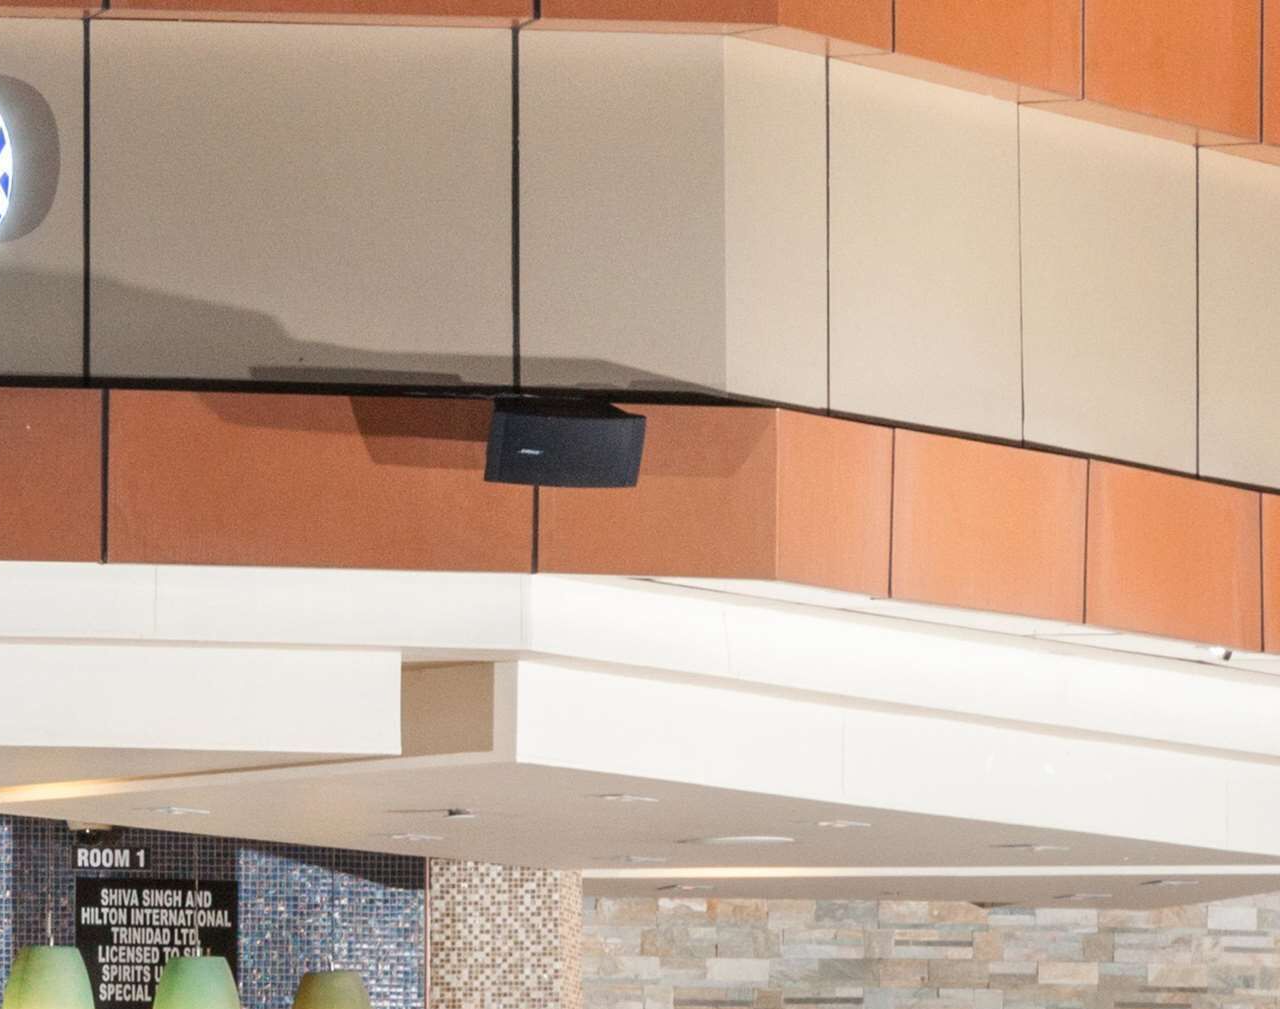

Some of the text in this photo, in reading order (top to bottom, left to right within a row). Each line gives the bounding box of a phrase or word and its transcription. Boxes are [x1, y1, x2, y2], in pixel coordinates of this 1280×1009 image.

[77, 848, 145, 868] ROOM 1
[100, 888, 212, 908] SHIVA SINGH AND
[81, 907, 232, 927] HILTON INTERNATIONAL
[111, 927, 171, 945] TRINIDAD
[98, 945, 160, 963] LICENSED
[102, 965, 151, 982] SPIRITS
[99, 984, 152, 1002] SPECIAL
